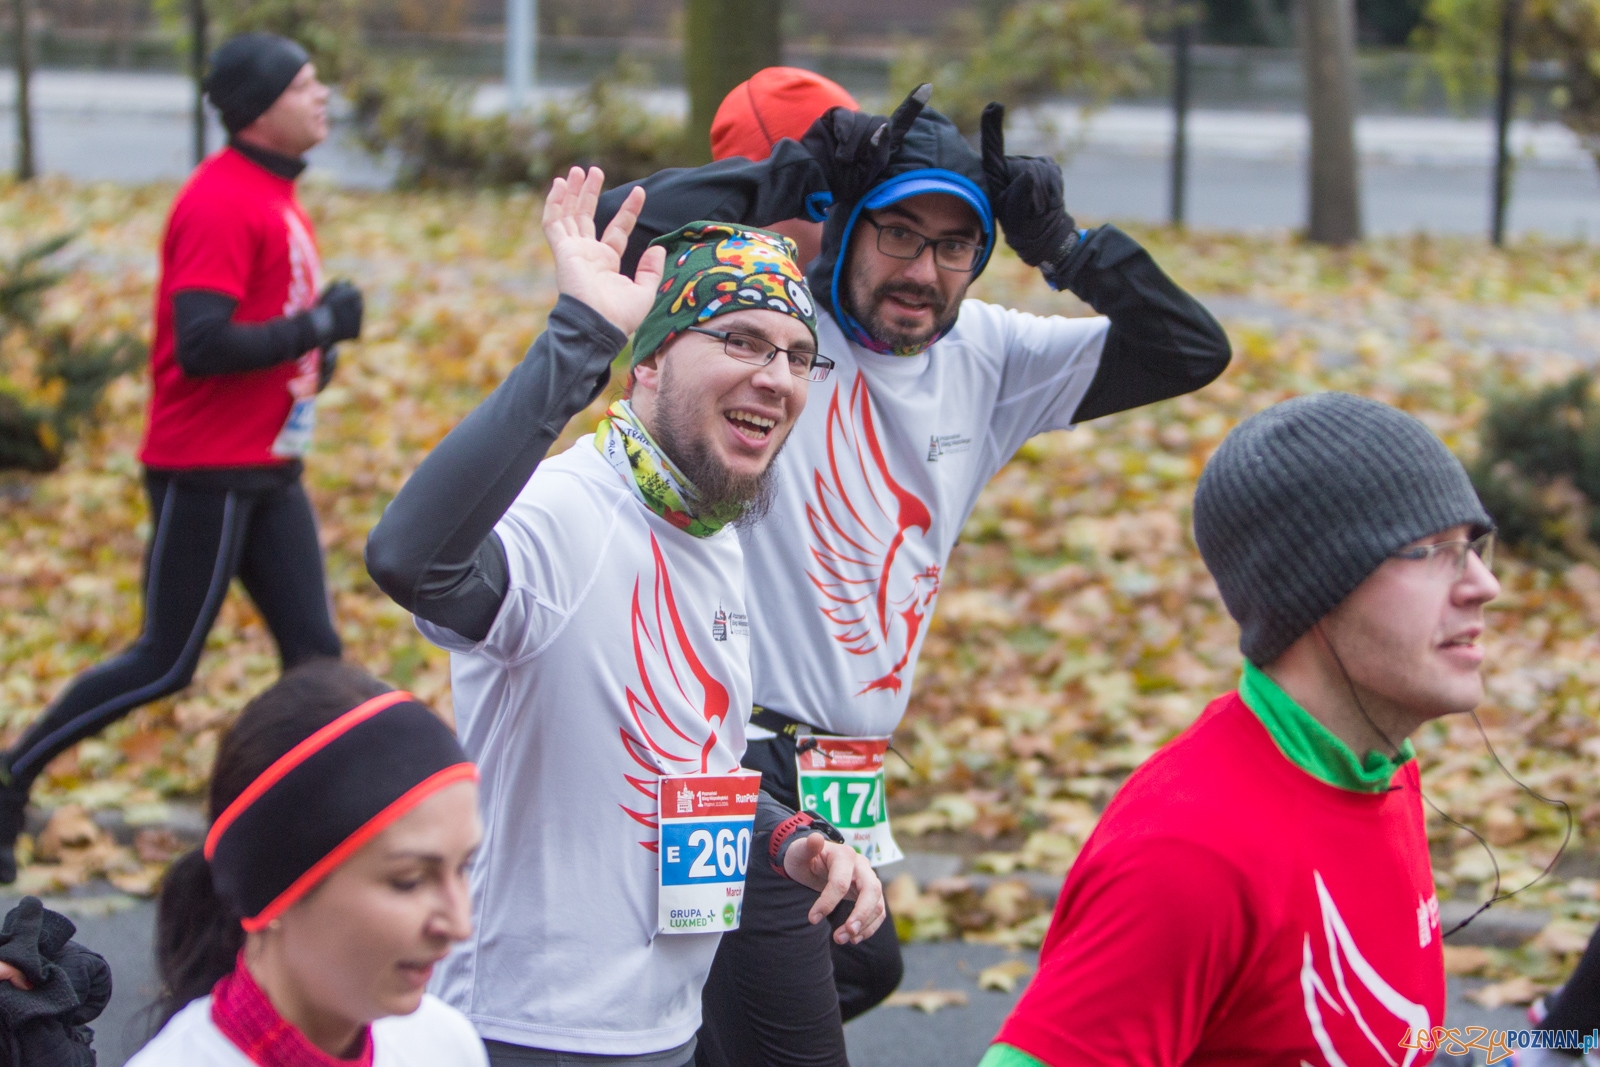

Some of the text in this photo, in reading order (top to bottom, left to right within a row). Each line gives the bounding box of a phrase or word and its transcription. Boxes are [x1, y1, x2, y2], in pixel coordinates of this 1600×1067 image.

[804, 778, 881, 825] C 174
[667, 827, 751, 878] E 260
[669, 917, 708, 928] LUXMED
[670, 908, 702, 919] GRUPA
